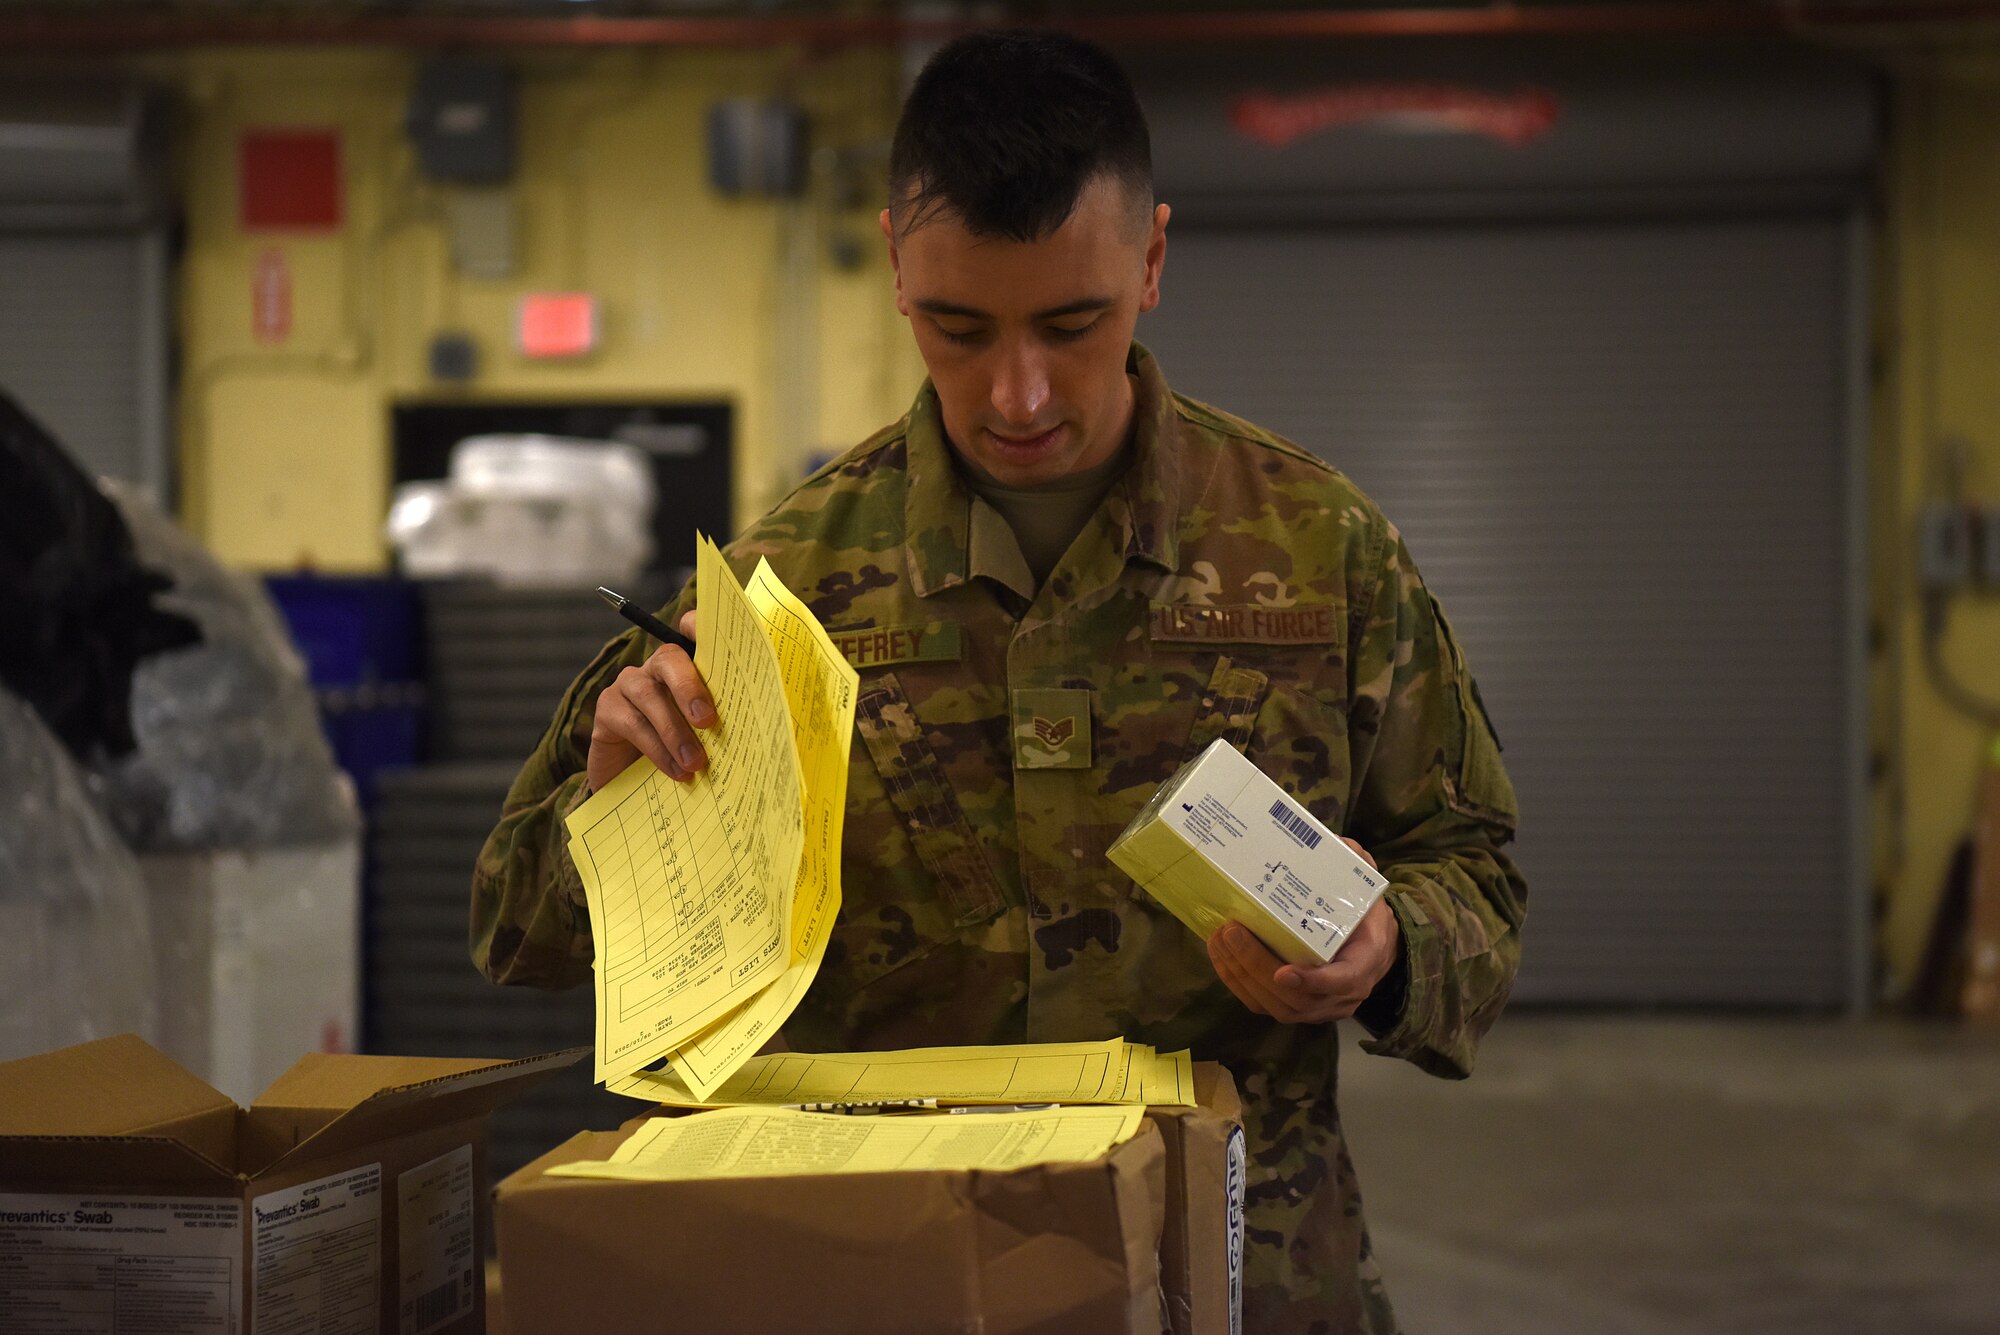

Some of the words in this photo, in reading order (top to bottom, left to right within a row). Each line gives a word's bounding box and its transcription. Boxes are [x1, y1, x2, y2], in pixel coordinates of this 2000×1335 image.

[1206, 608, 1249, 638] AIR
[1252, 608, 1331, 638] FORCE
[838, 630, 924, 663] FFREY
[716, 883, 725, 893] DATA
[816, 857, 828, 912] CONTENTS
[1363, 875, 1375, 887] 1953
[717, 888, 726, 899] DATA
[733, 884, 743, 898] STOP
[691, 909, 706, 924] PALLET
[803, 918, 816, 947] LIST
[738, 956, 759, 977] LIST
[655, 1015, 672, 1027] PAGE:
[655, 1020, 673, 1032] DATE:
[614, 1032, 651, 1054] 09/10/2019
[0, 1211, 67, 1223] revantics
[73, 1210, 113, 1224] Swab
[257, 1206, 297, 1224] Prevantics
[300, 1196, 320, 1212] Swab
